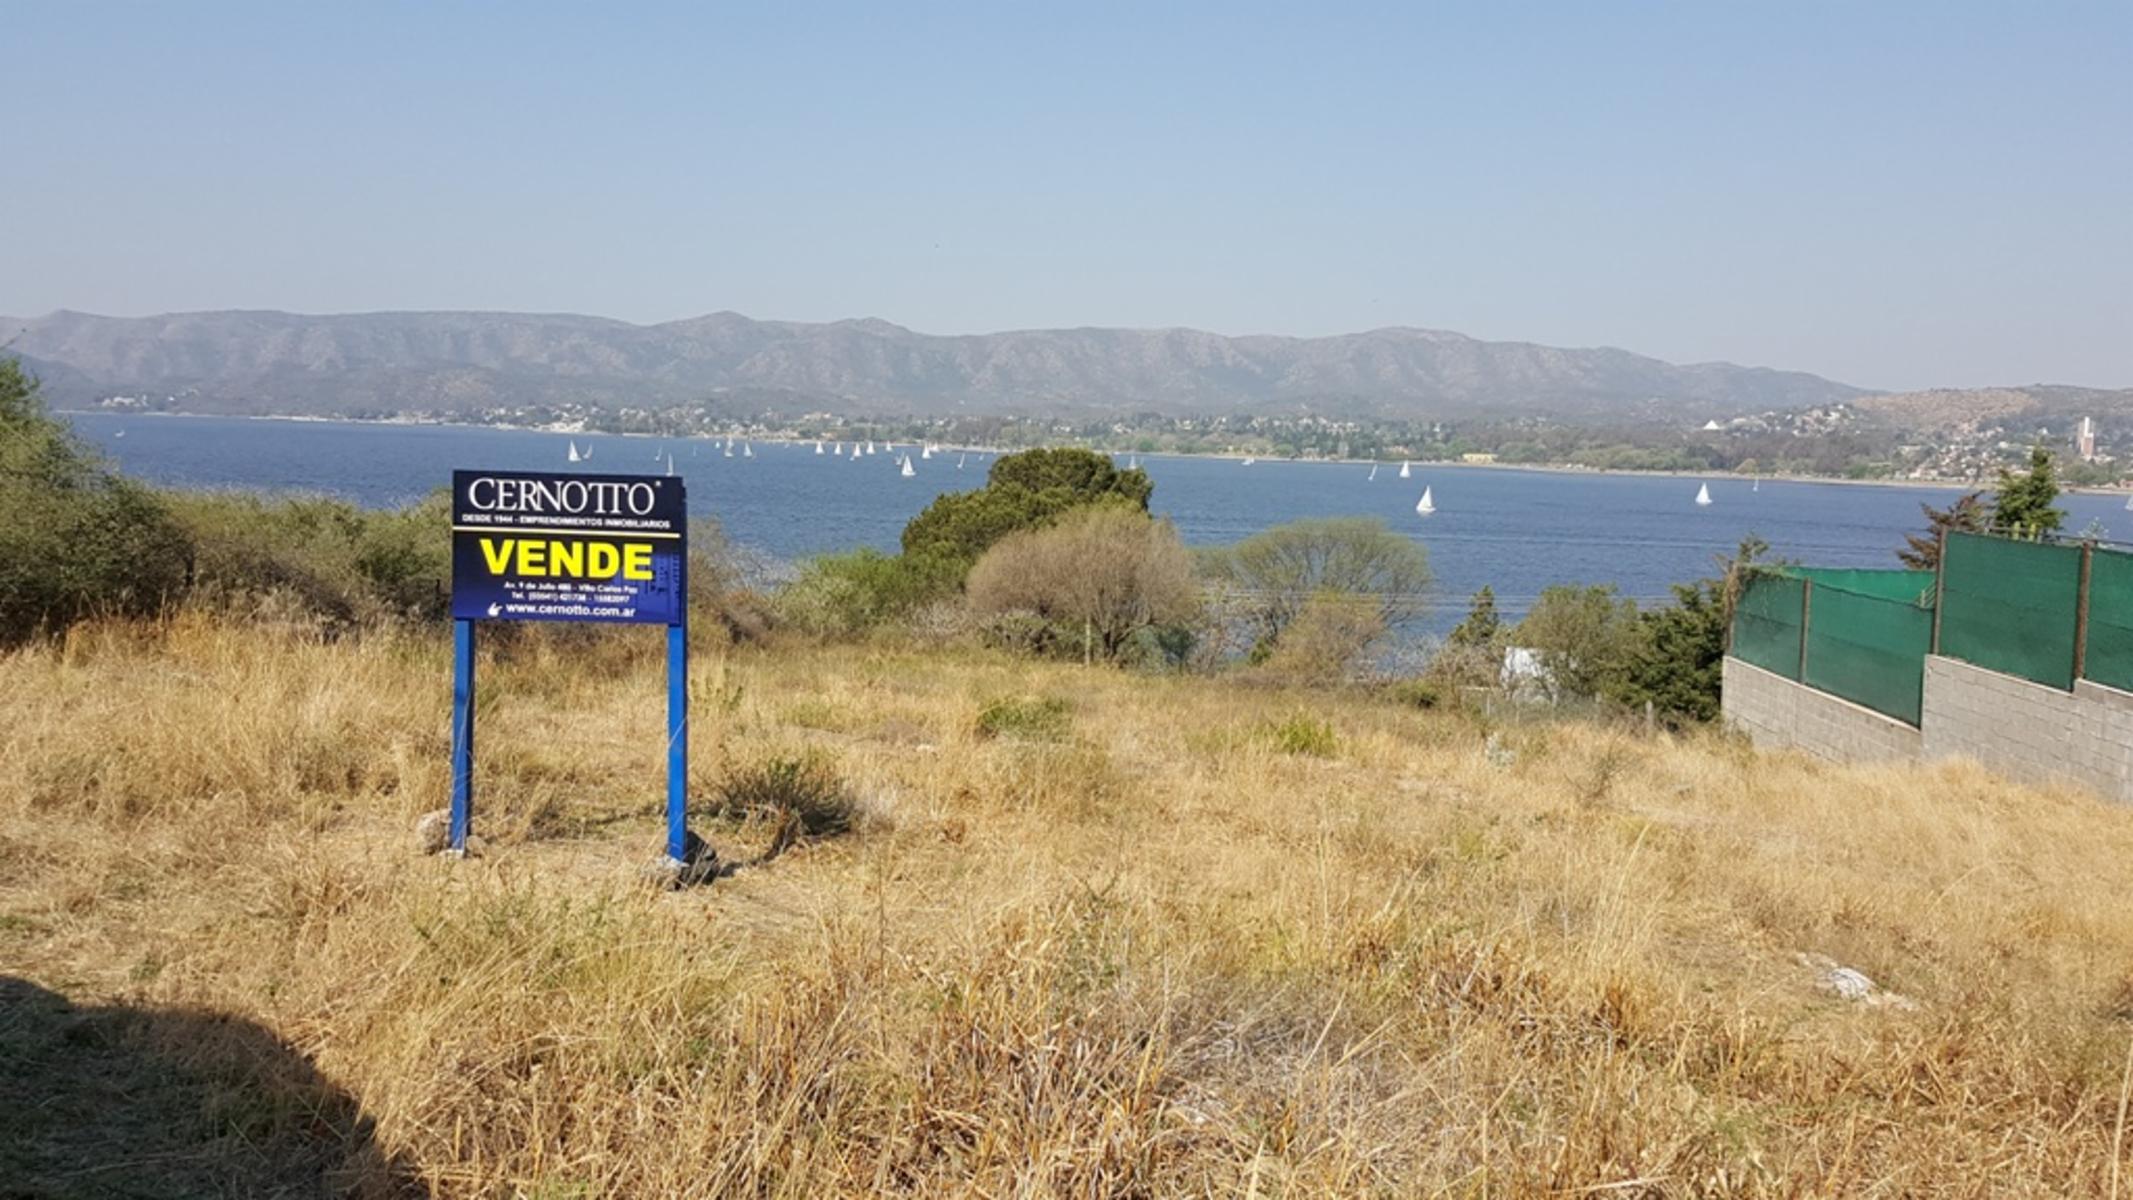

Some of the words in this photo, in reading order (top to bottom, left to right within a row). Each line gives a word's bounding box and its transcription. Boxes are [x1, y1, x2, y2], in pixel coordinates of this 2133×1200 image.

[468, 478, 655, 515] CERNOTTO
[462, 513, 491, 524] DESDE
[520, 515, 602, 527] EMPRENDIMIENTOS
[605, 519, 670, 529] INMOBILIARIOS
[480, 538, 653, 580] VENDE
[506, 602, 635, 617] www.cernotto.com.ar
